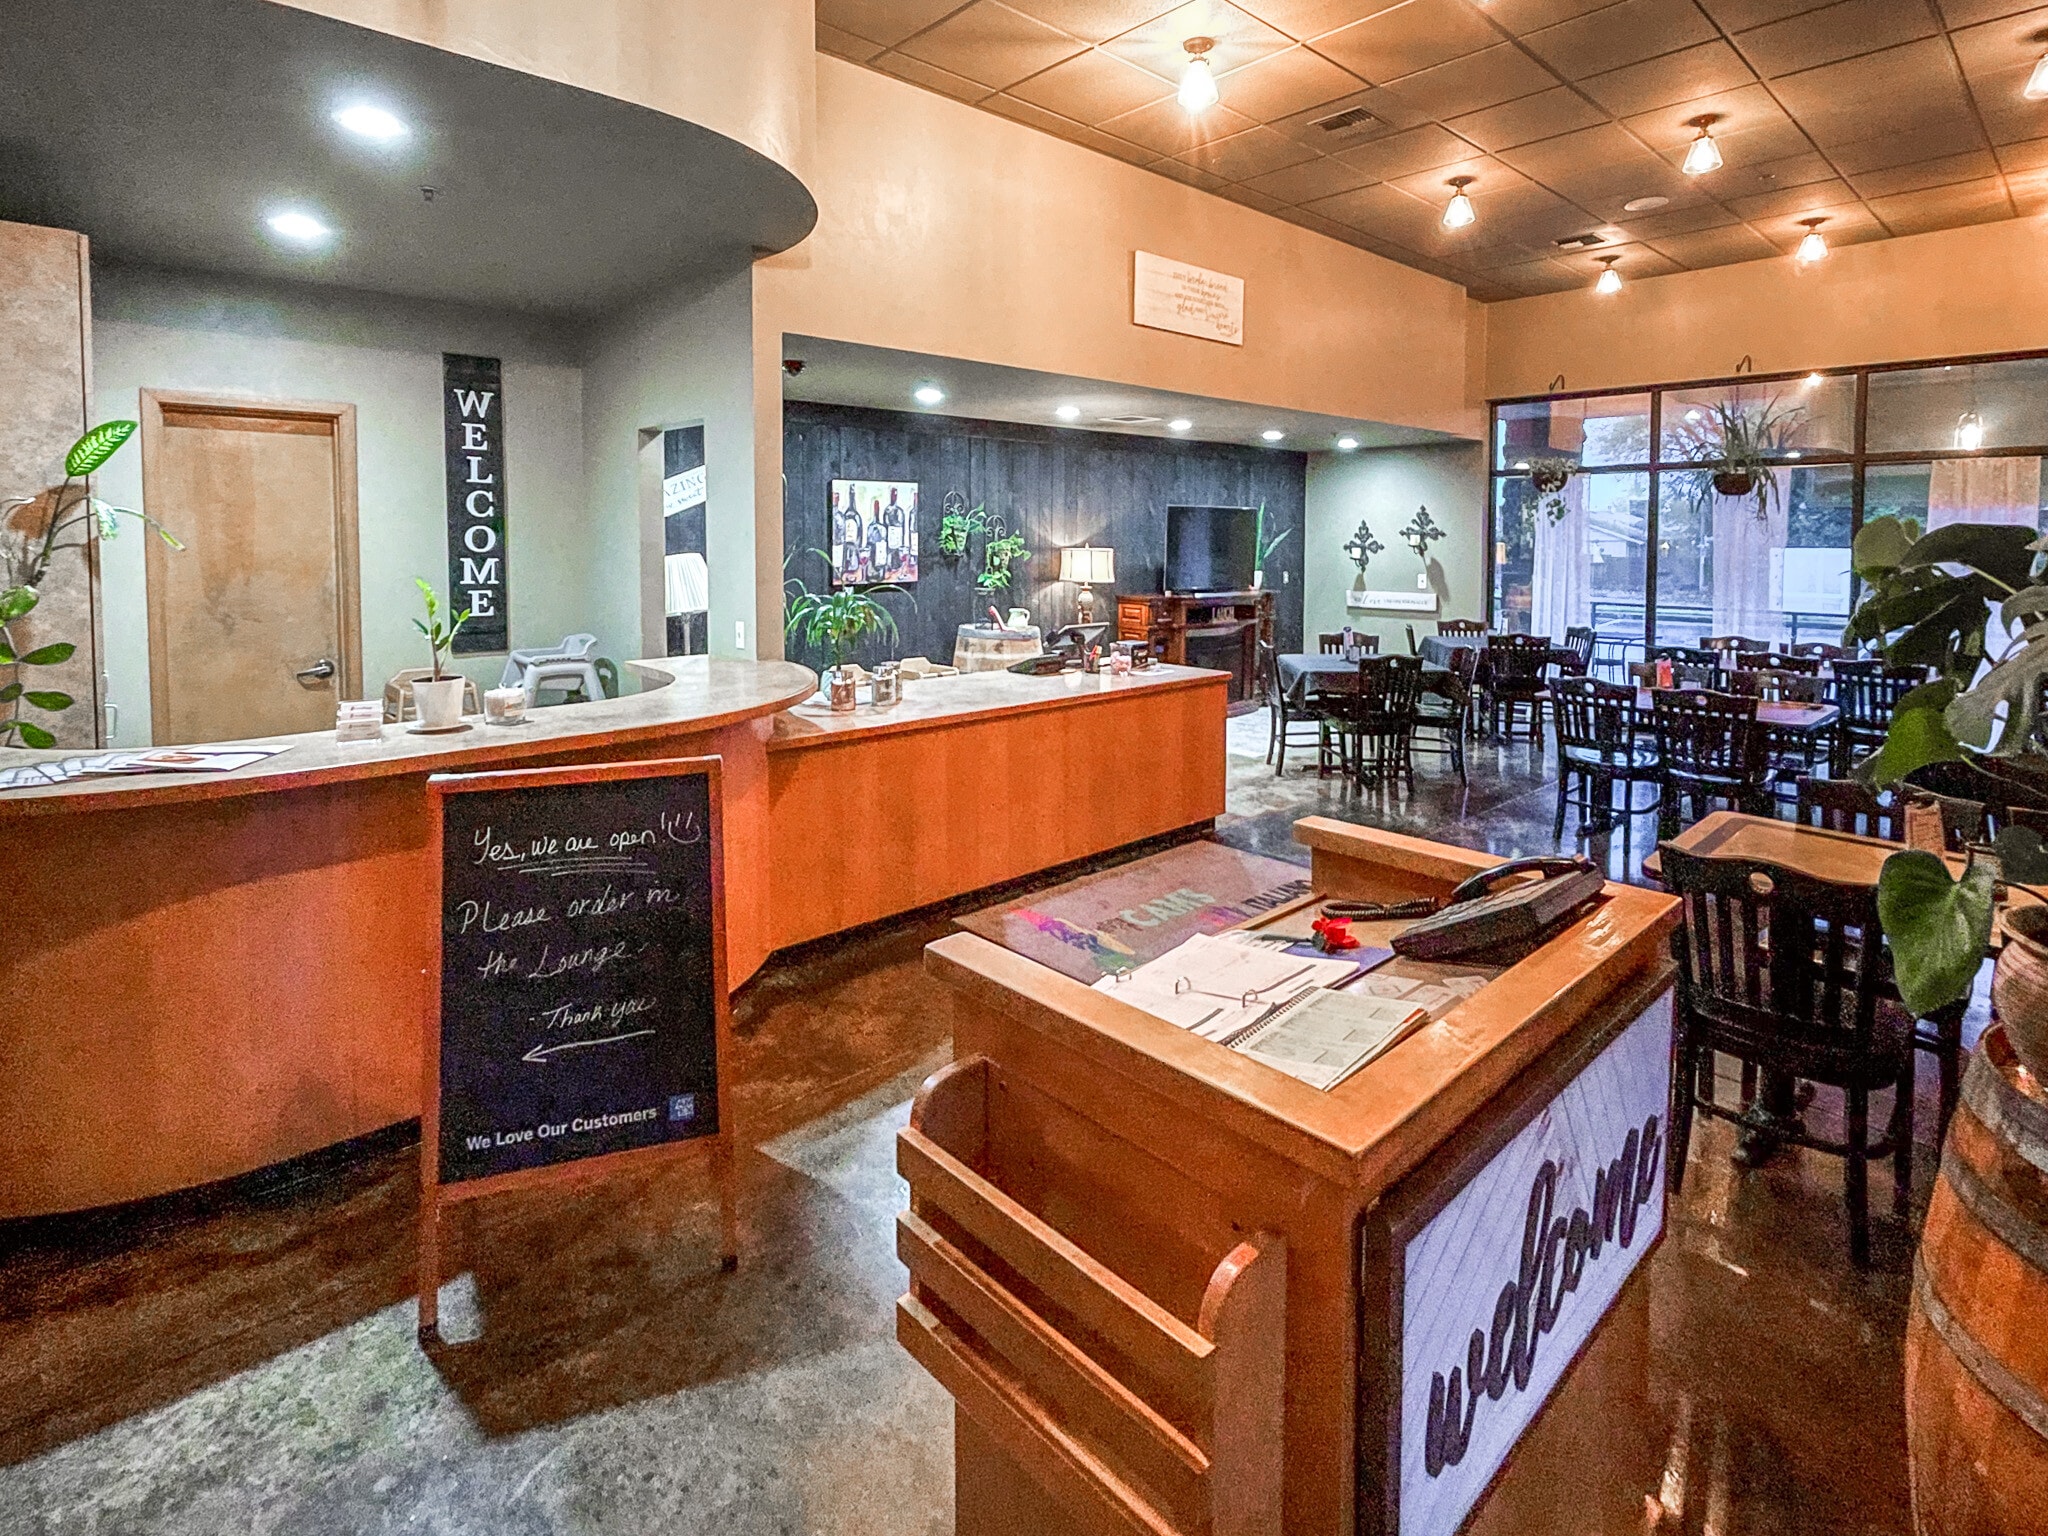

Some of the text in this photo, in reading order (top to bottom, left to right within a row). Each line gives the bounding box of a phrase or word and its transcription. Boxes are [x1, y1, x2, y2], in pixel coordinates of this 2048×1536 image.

[453, 388, 500, 617] WELCOME
[474, 826, 526, 865] Yes,
[531, 835, 558, 857] we
[565, 836, 599, 853] are
[456, 878, 681, 934] Please order in
[477, 944, 632, 979] the Lounge
[611, 996, 657, 1024] you
[466, 1128, 491, 1151] We
[495, 1125, 534, 1148] Love
[538, 1121, 568, 1139] Our
[572, 1106, 658, 1134] Customers
[1424, 1115, 1661, 1478] welcome
